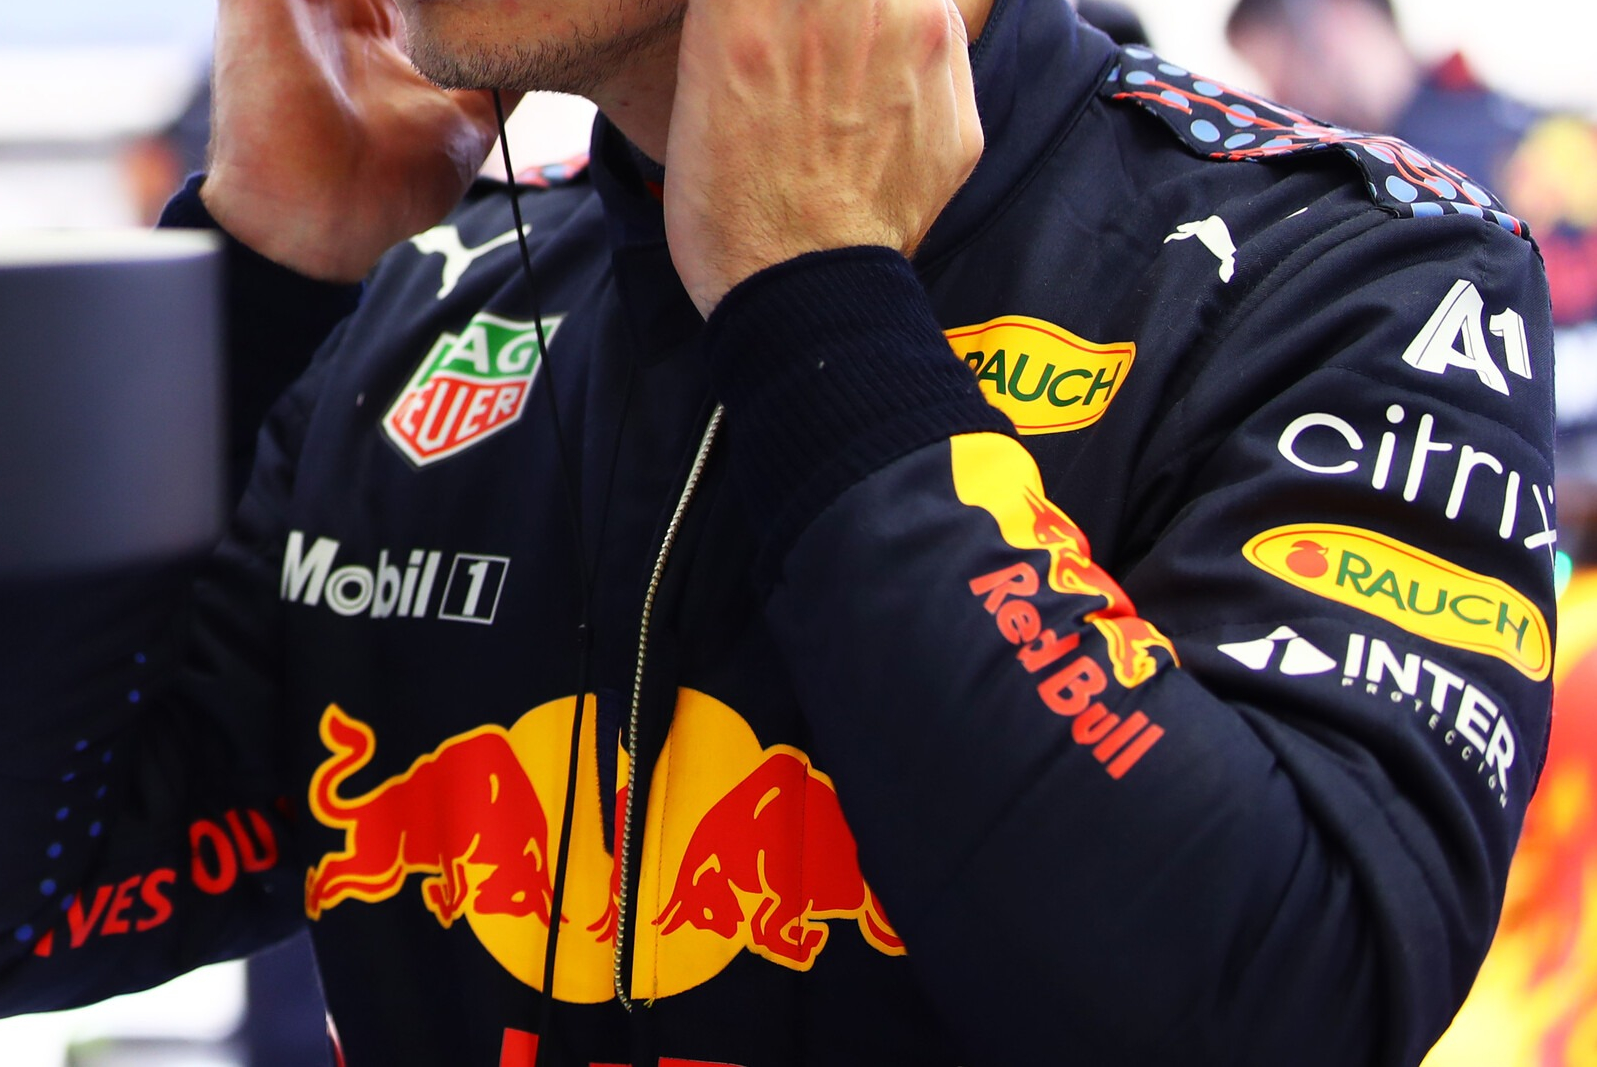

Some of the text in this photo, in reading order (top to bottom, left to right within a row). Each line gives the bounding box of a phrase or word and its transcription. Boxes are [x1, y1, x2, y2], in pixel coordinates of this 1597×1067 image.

[440, 325, 542, 374] AG
[1402, 279, 1533, 396] A1
[280, 530, 442, 619] Mobil
[1336, 550, 1529, 651] RAUCH
[969, 561, 1166, 781] Red Bull
[1343, 633, 1515, 792] INTER
[34, 807, 279, 958] VES OU
